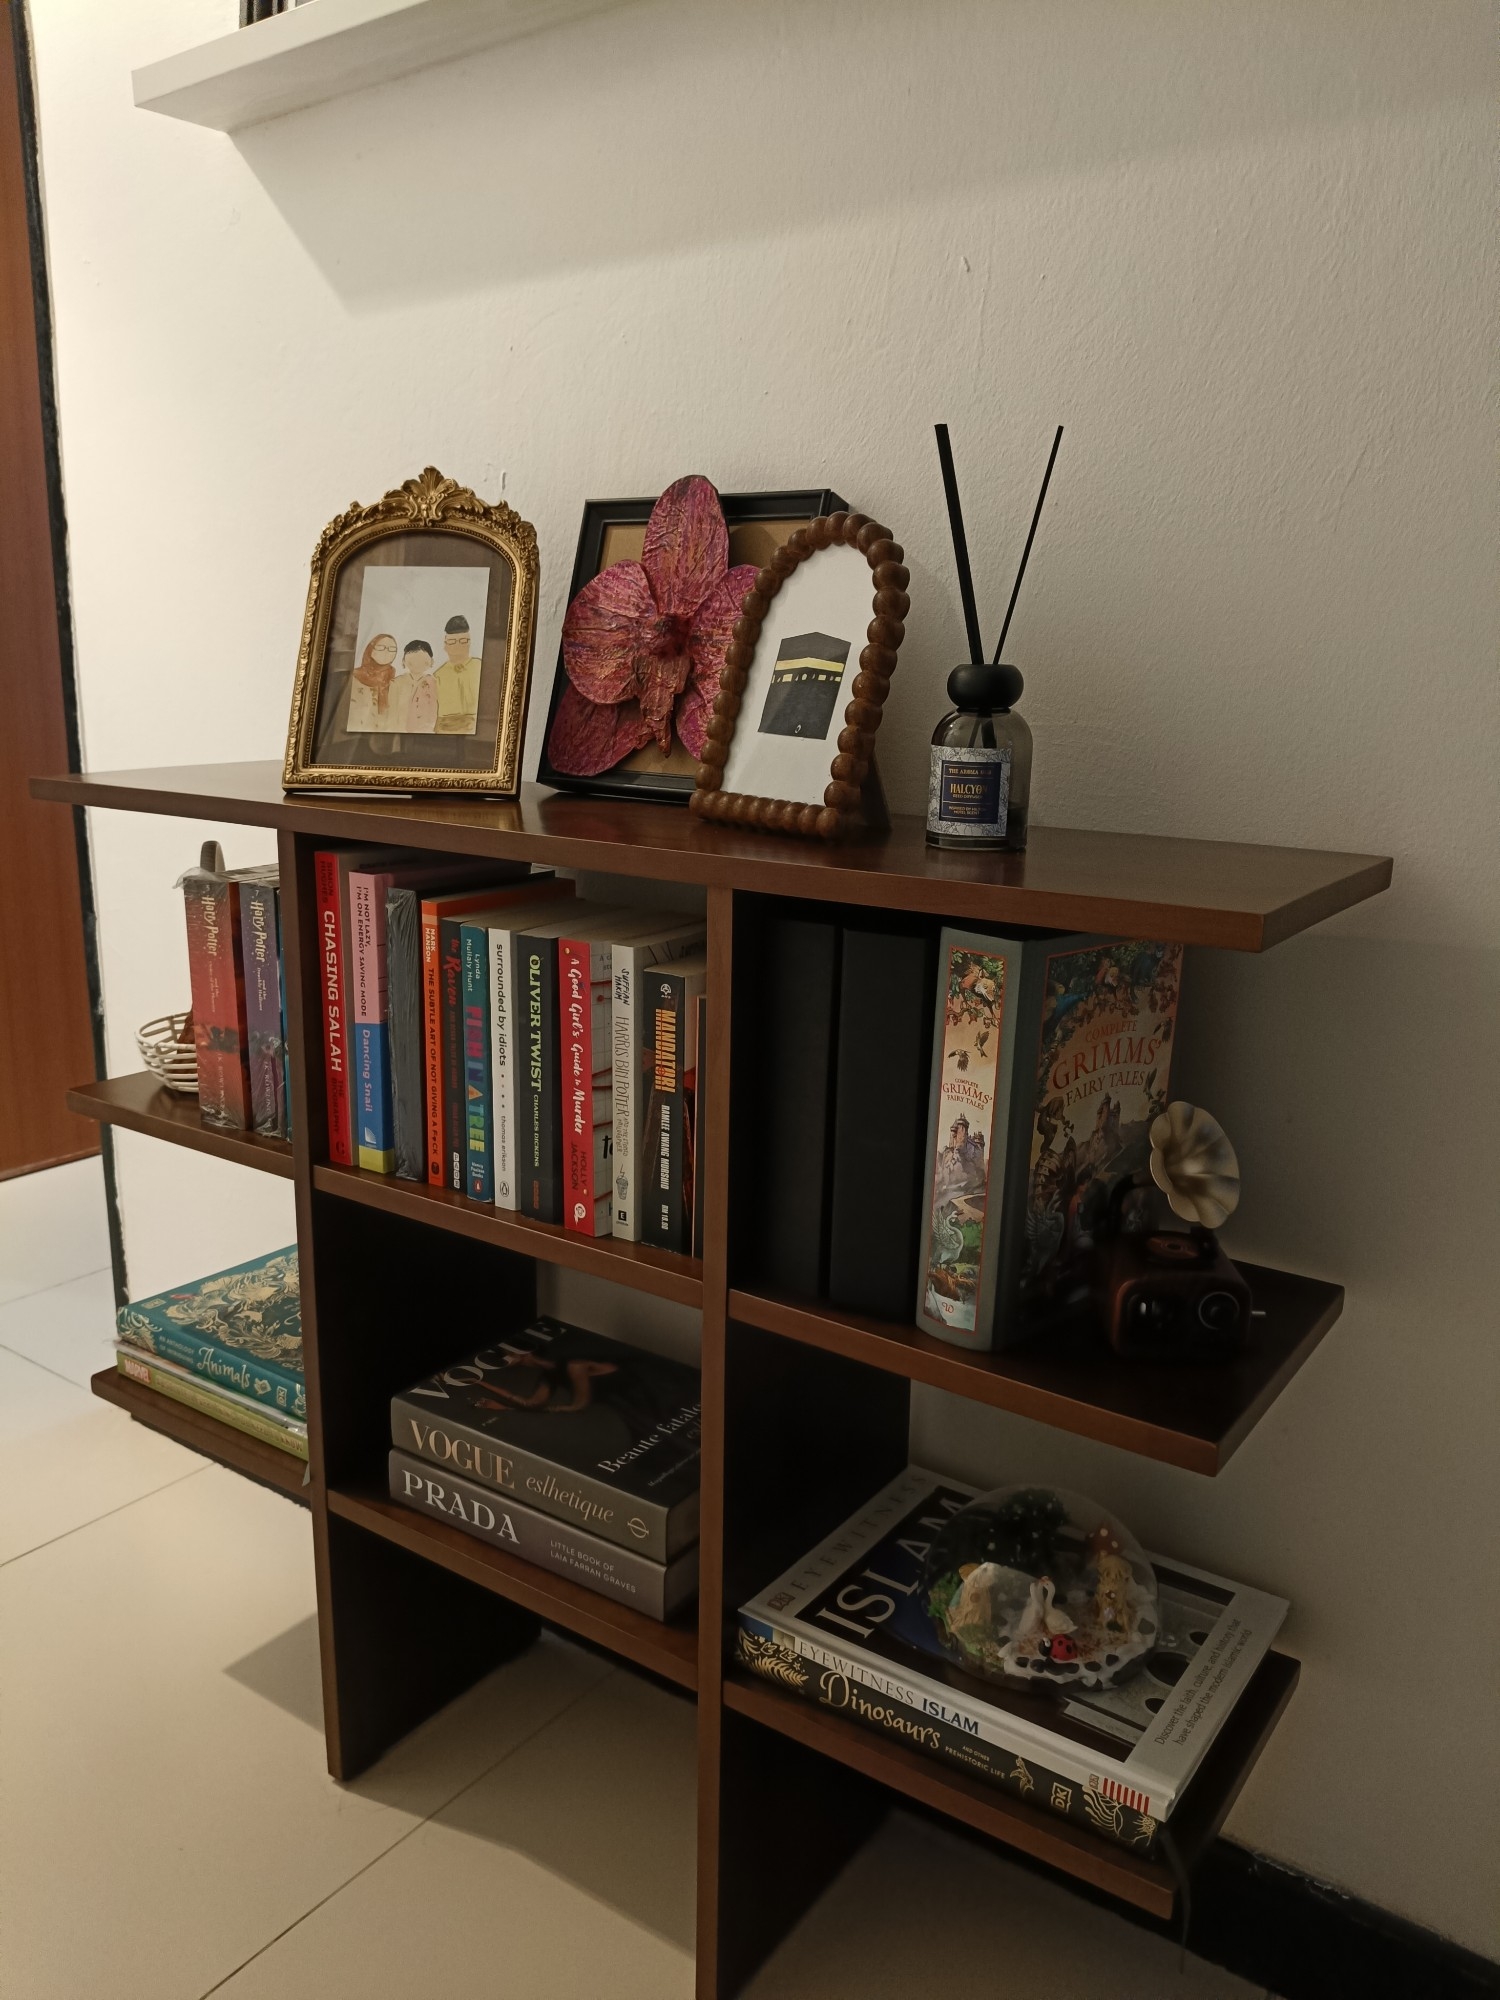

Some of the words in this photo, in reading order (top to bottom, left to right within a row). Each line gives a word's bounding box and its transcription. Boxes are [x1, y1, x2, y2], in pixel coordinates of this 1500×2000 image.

[950, 783, 988, 795] HALCYO
[201, 896, 216, 926] Harry
[250, 900, 264, 931] Harry
[357, 902, 363, 916] ON
[203, 925, 219, 957] Potter
[252, 931, 268, 963] Potter
[324, 910, 339, 1001] CHASING
[497, 943, 506, 1013] surrounded
[529, 954, 541, 1027] OLIVER
[567, 968, 582, 999] Good
[621, 968, 630, 1006] SUFFIAN
[428, 989, 436, 1025] SUBTLE
[497, 1016, 507, 1031] by
[568, 1003, 584, 1038] Girl's
[328, 1004, 342, 1072] SALAH
[429, 1027, 437, 1046] ART
[465, 1005, 484, 1058] FISH
[614, 1015, 630, 1058] HARRIS
[1086, 1019, 1137, 1043] COMPLETE
[362, 1029, 372, 1079] Dancing
[430, 1048, 437, 1061] OF
[499, 1033, 507, 1066] idiots
[530, 1030, 542, 1092] TWIST
[571, 1043, 584, 1077] Guide
[467, 1061, 484, 1082] IN
[615, 1058, 630, 1079] BIN
[955, 1078, 979, 1088] COMPLETE
[364, 1081, 373, 1112] Snail
[615, 1080, 630, 1118] POTTER
[946, 1094, 965, 1102] FAIRY
[965, 1098, 985, 1110] TALES
[1065, 1074, 1106, 1107] FAIRY
[1109, 1070, 1145, 1087] TALES
[468, 1104, 485, 1153] TREE
[572, 1087, 586, 1136] Murder
[660, 1104, 670, 1130] RAMLEE
[660, 1131, 670, 1157] AWANG
[571, 1142, 579, 1191] JACKSON
[660, 1157, 670, 1190] MURSHID
[197, 1347, 250, 1389] Animals
[408, 1322, 568, 1399] VOGUE
[409, 1418, 516, 1490] VOGUE
[402, 1469, 521, 1545] PRADA
[550, 1540, 576, 1556] LITTLE
[577, 1551, 601, 1567] BOOK
[603, 1562, 615, 1573] OF
[550, 1550, 569, 1564] LAIA
[570, 1557, 601, 1578] FARRAN
[603, 1572, 637, 1593] GRAVES
[816, 1496, 964, 1640] ISLAM
[800, 1641, 914, 1705] EYEWITNESS
[922, 1698, 980, 1736] ISLAM
[1154, 1715, 1179, 1745] Discover
[1175, 1702, 1187, 1716] the
[1208, 1651, 1219, 1666] and
[818, 1669, 941, 1749] Dinosaurs
[1174, 1728, 1191, 1746] have
[1186, 1703, 1206, 1731] shaped
[945, 1746, 989, 1772] PREHISTORIC
[990, 1767, 1006, 1780] LIFE
[962, 1745, 974, 1754] AND
